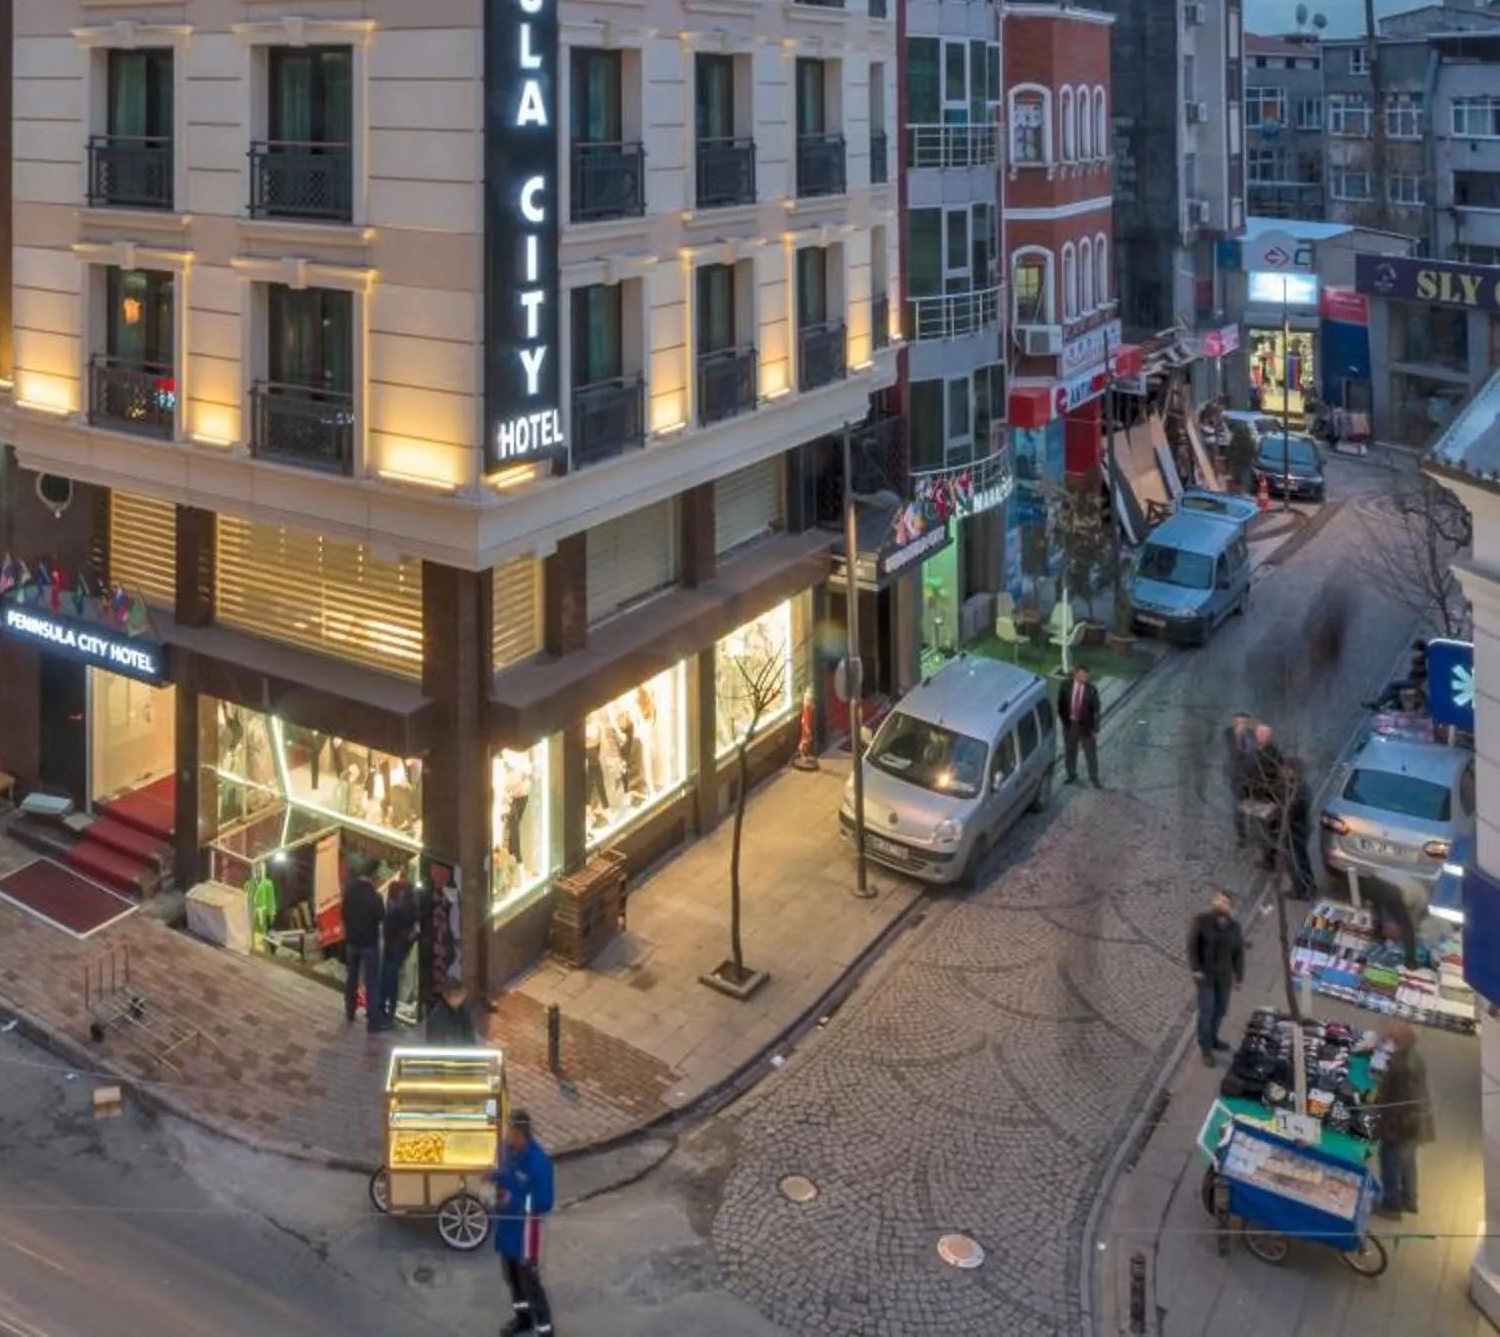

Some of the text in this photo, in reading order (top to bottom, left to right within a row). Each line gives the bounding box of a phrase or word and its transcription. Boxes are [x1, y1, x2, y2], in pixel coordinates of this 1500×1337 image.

[518, 176, 548, 395] CITY
[1416, 269, 1484, 306] SLY
[499, 408, 563, 460] HOTEL
[7, 610, 155, 674] PENINSULA CITY HOTEL
